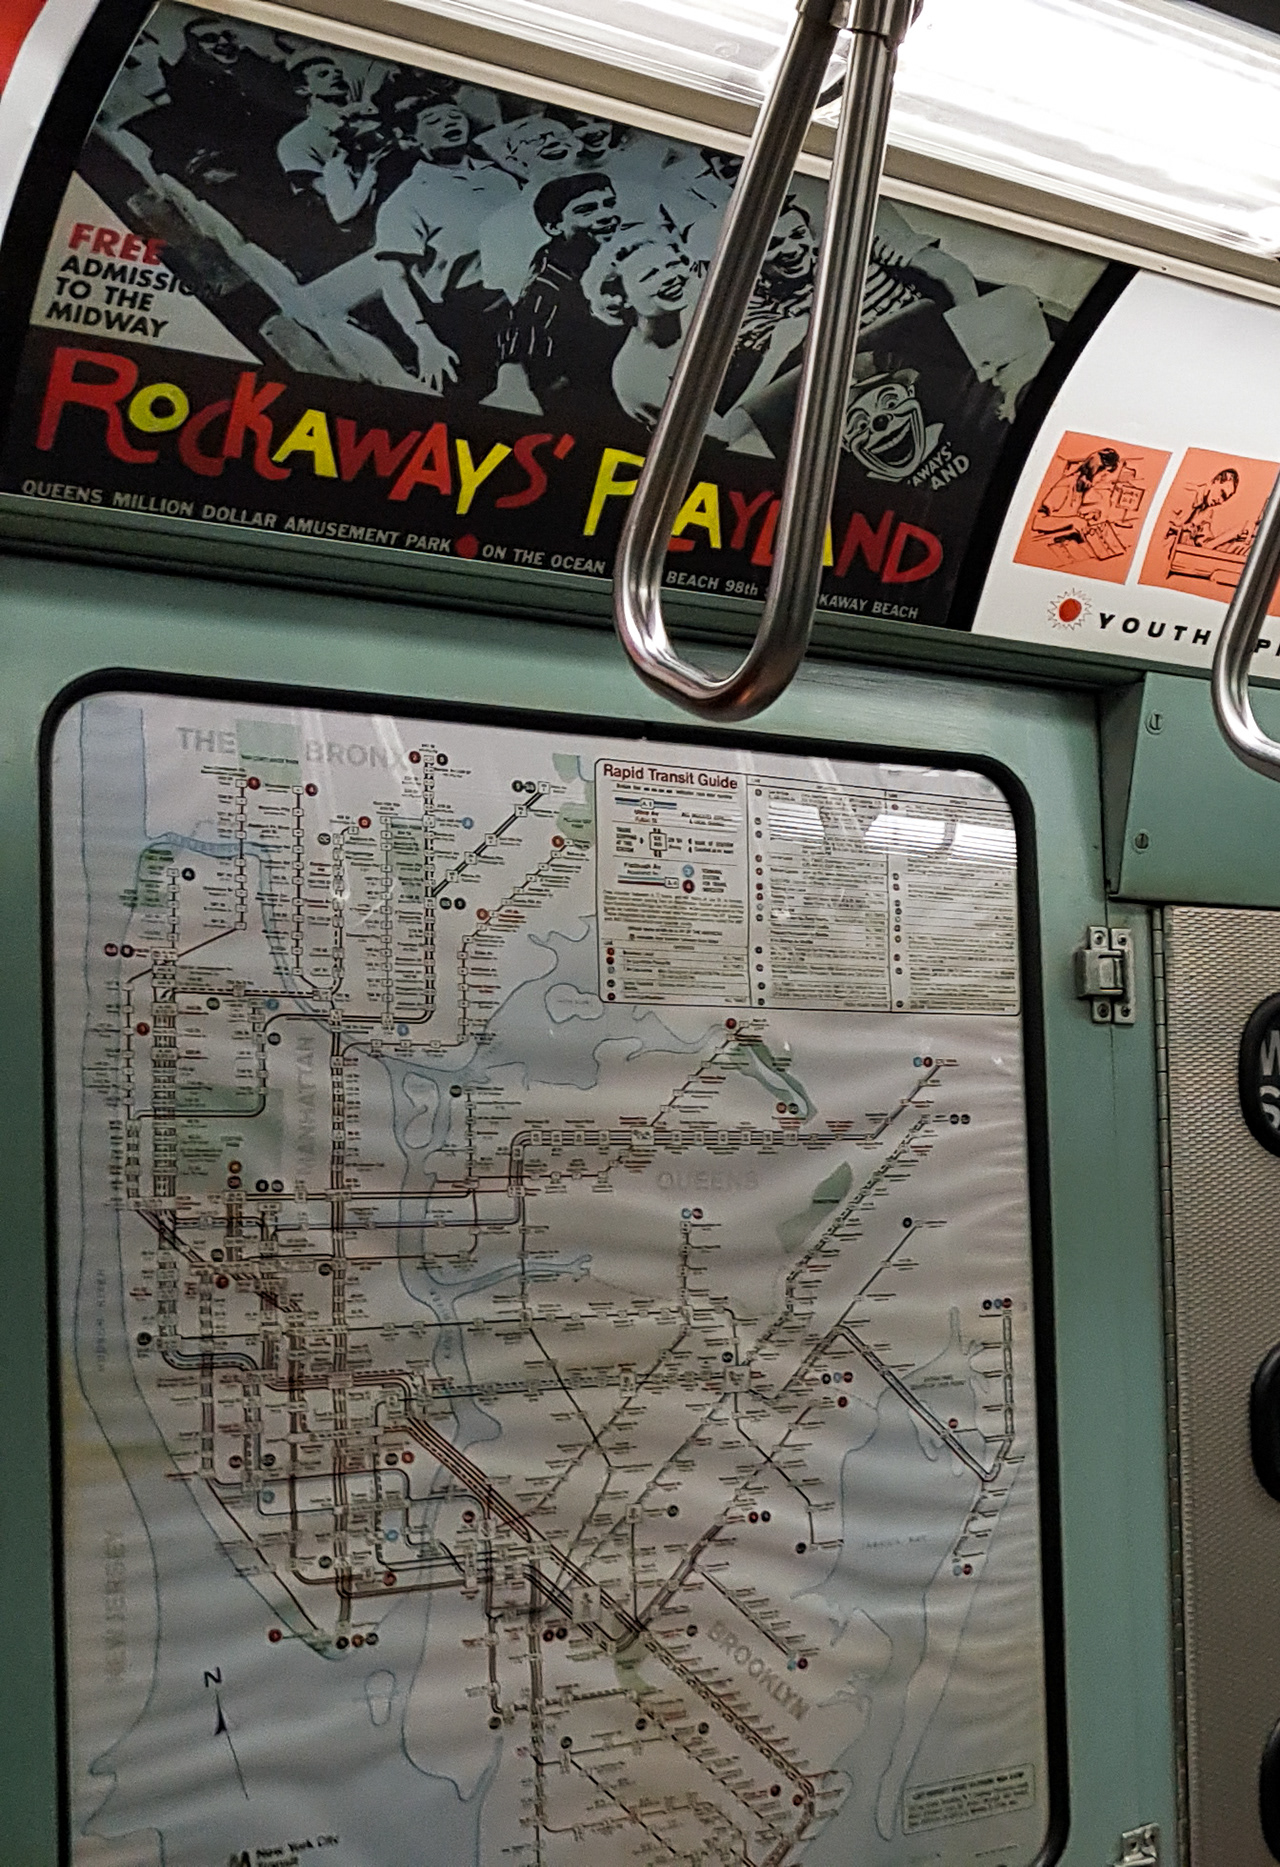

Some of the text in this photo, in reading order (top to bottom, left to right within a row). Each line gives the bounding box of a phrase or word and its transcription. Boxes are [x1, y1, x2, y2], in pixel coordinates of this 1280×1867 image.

[68, 223, 167, 265] FREE
[55, 277, 155, 312] TO THE
[46, 301, 168, 337] MIDWAY
[930, 455, 970, 490] AND
[21, 479, 103, 505] QUEENS
[112, 491, 194, 517] MILLION
[201, 504, 278, 528] DOLLAR
[283, 516, 400, 546] AMUSEMENT
[404, 534, 451, 553] PARK
[482, 544, 507, 560] ON
[513, 548, 544, 566] THE
[551, 554, 606, 574] OCEAN
[666, 570, 721, 592] BEACH
[725, 579, 759, 596] 98th
[871, 602, 919, 620] BEACH
[1099, 612, 1212, 646] YOUTH
[177, 727, 236, 756] THE
[603, 763, 738, 789] Rapid Transit Guide
[655, 1170, 758, 1190] QUEENS
[204, 1667, 222, 1687] N
[707, 1620, 811, 1721] BROOKLYN
